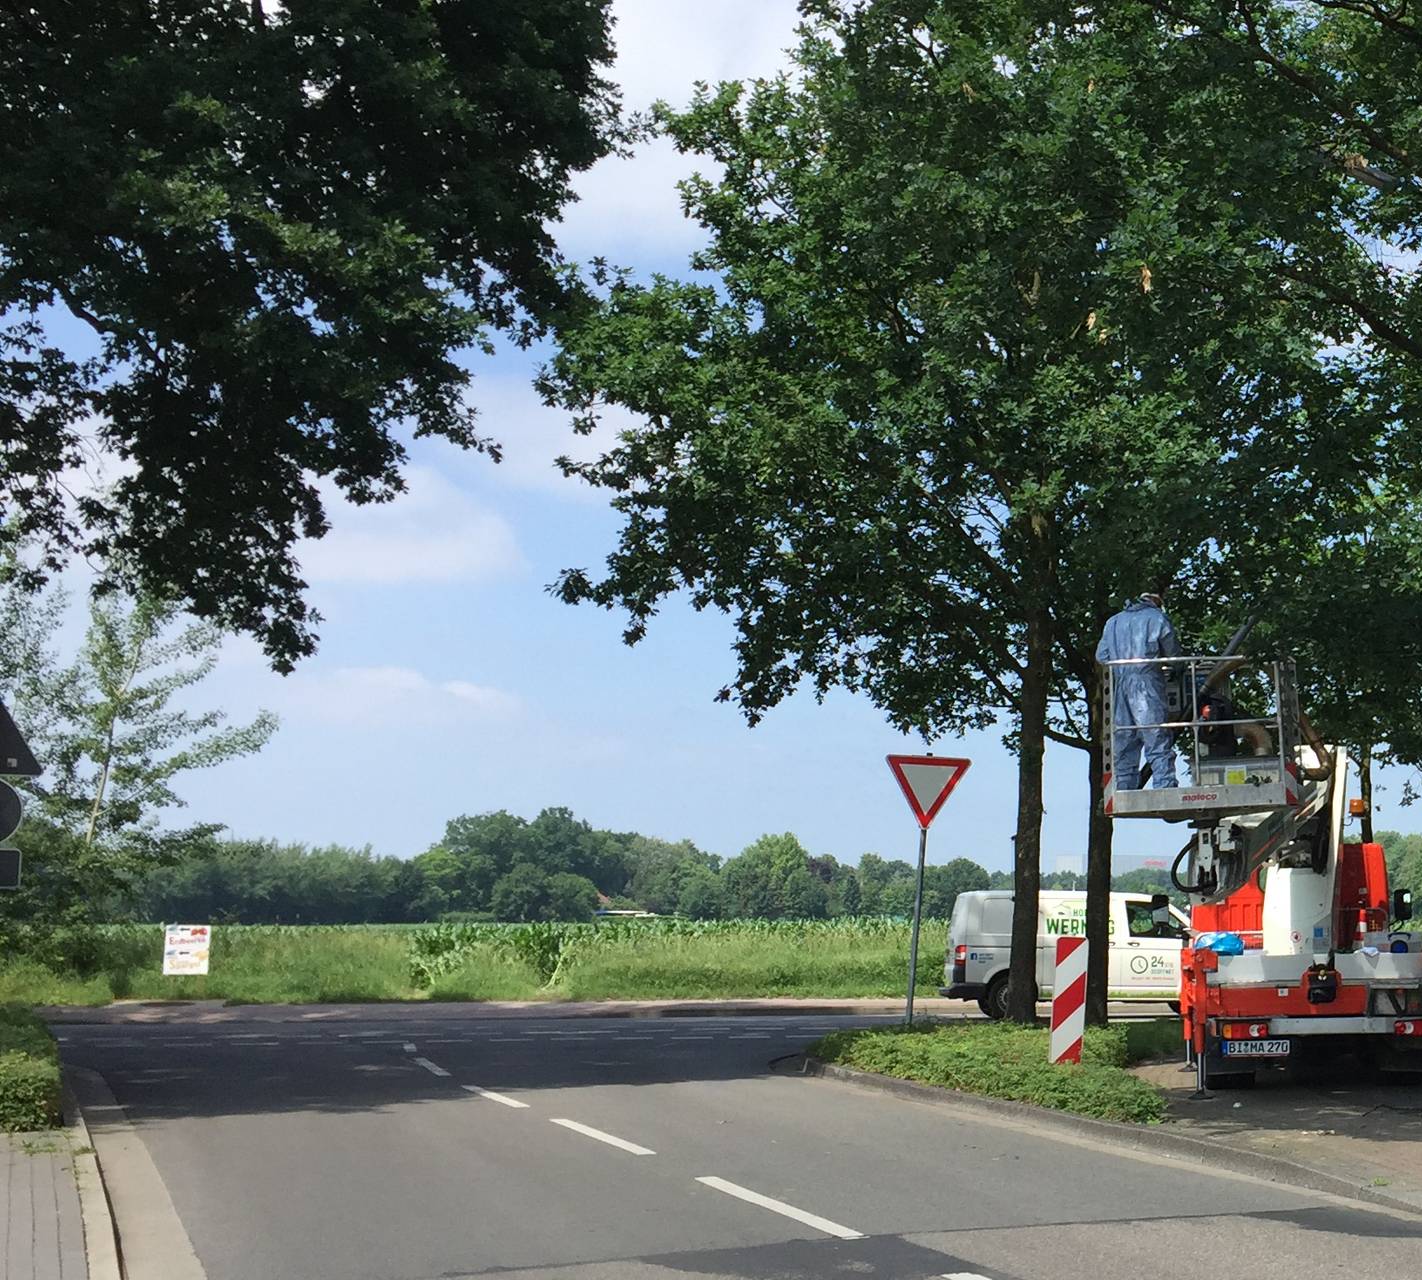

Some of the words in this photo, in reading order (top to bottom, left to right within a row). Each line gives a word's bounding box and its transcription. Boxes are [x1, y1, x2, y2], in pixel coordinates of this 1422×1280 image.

[1151, 955, 1164, 968] 24
[1250, 1042, 1265, 1053] MA
[1267, 1041, 1288, 1053] 270
